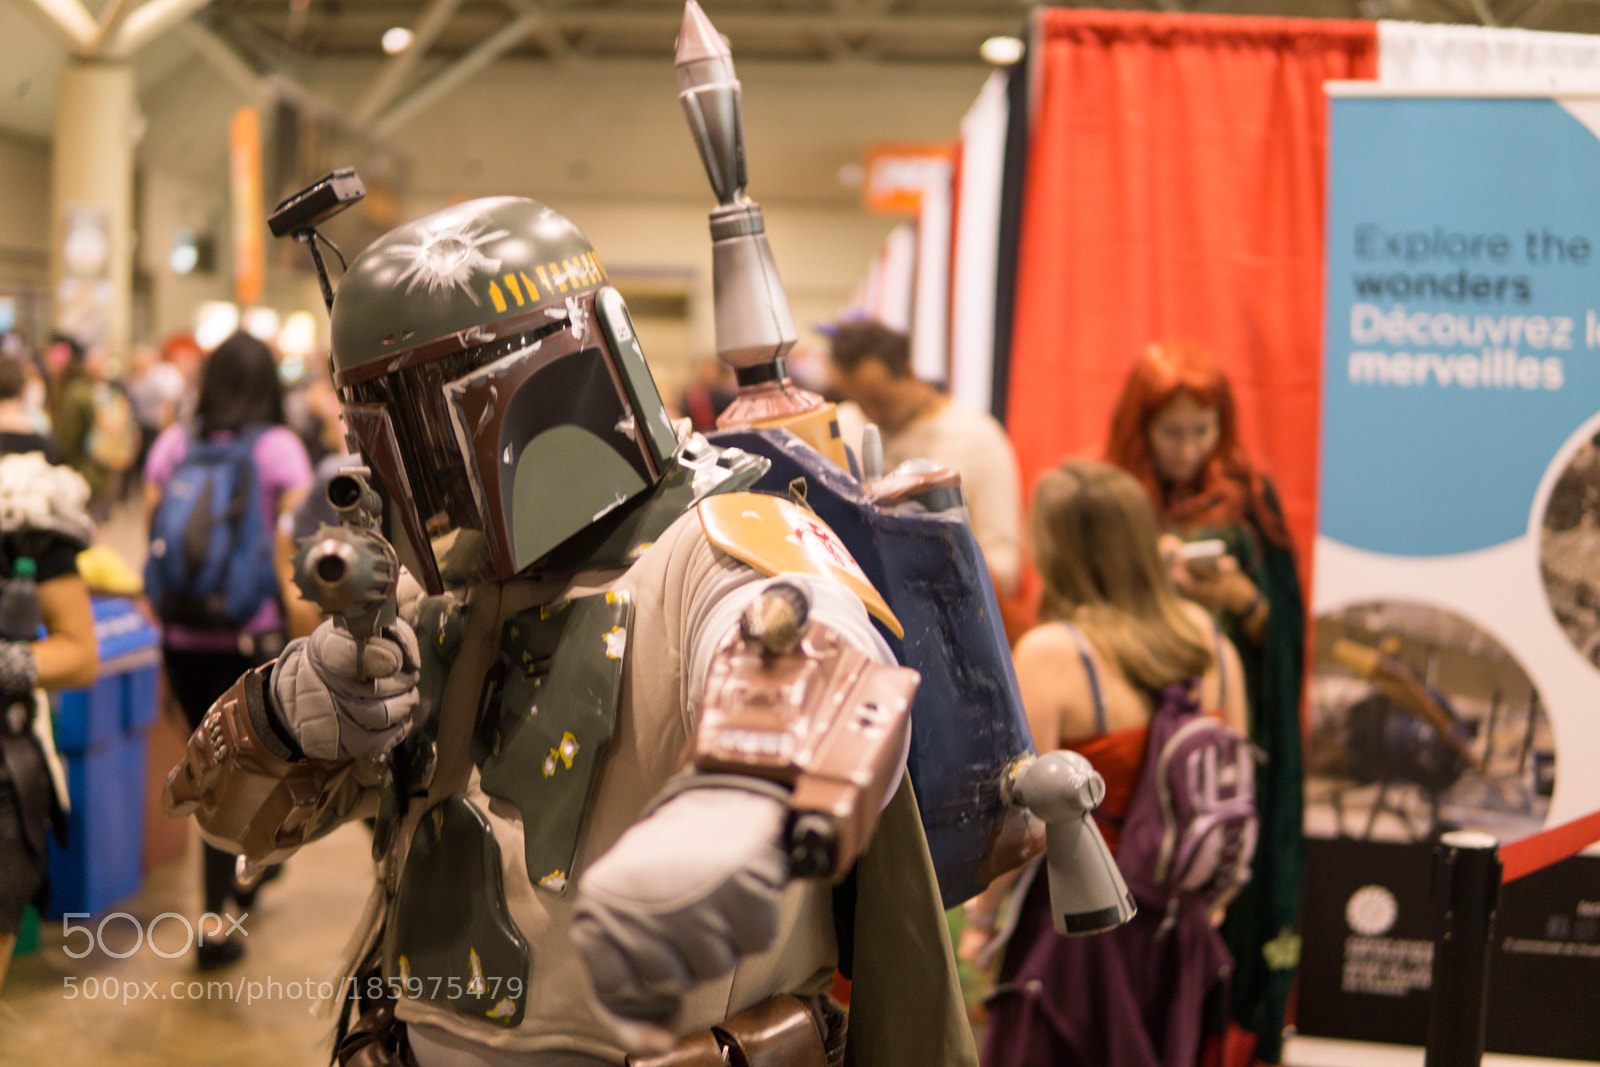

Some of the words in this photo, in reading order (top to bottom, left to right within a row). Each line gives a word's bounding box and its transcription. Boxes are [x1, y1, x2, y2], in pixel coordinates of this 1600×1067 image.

[1352, 223, 1510, 264] Explore
[1525, 228, 1592, 265] the
[1352, 270, 1532, 303] wonders
[1350, 302, 1575, 350] Découvrez
[1348, 350, 1564, 391] merveilles
